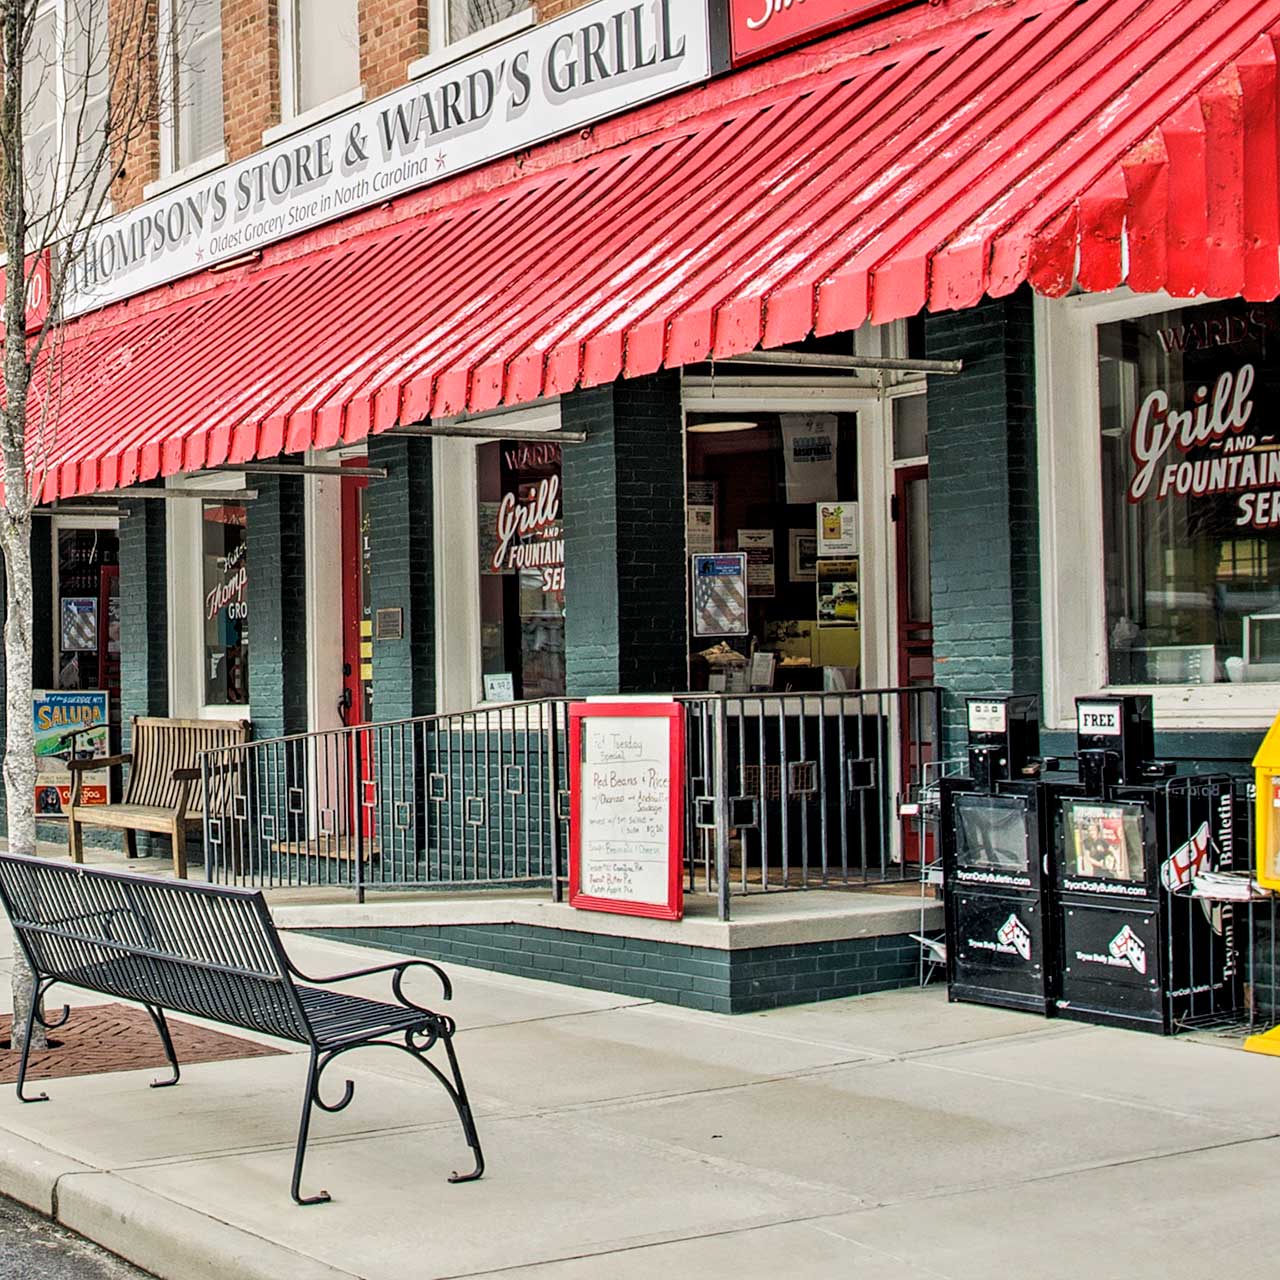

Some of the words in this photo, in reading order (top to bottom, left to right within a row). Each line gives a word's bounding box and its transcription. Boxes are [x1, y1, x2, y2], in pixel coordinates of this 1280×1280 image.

[236, 134, 334, 212] STORE
[344, 121, 370, 167] &
[379, 50, 531, 152] WARD'S
[209, 229, 243, 256] Oldest
[244, 213, 286, 243] Grocery
[287, 201, 319, 226] Store
[320, 194, 332, 212] in
[334, 178, 369, 208] North
[372, 156, 428, 192] Carolina
[1130, 363, 1255, 500] Grill
[1223, 435, 1257, 453] AND
[494, 474, 560, 570] Grill
[543, 528, 560, 538] AND
[508, 540, 565, 569] FOUNTAIN
[228, 601, 248, 620] GRO
[38, 705, 102, 731] SALUDA
[1084, 713, 1116, 728] FREE
[1217, 793, 1233, 866] Bulletin
[957, 870, 1031, 887] TryonDailyBulletin.com
[1063, 879, 1147, 897] TryonDailyBulletin.com
[1222, 925, 1240, 982] Tryon
